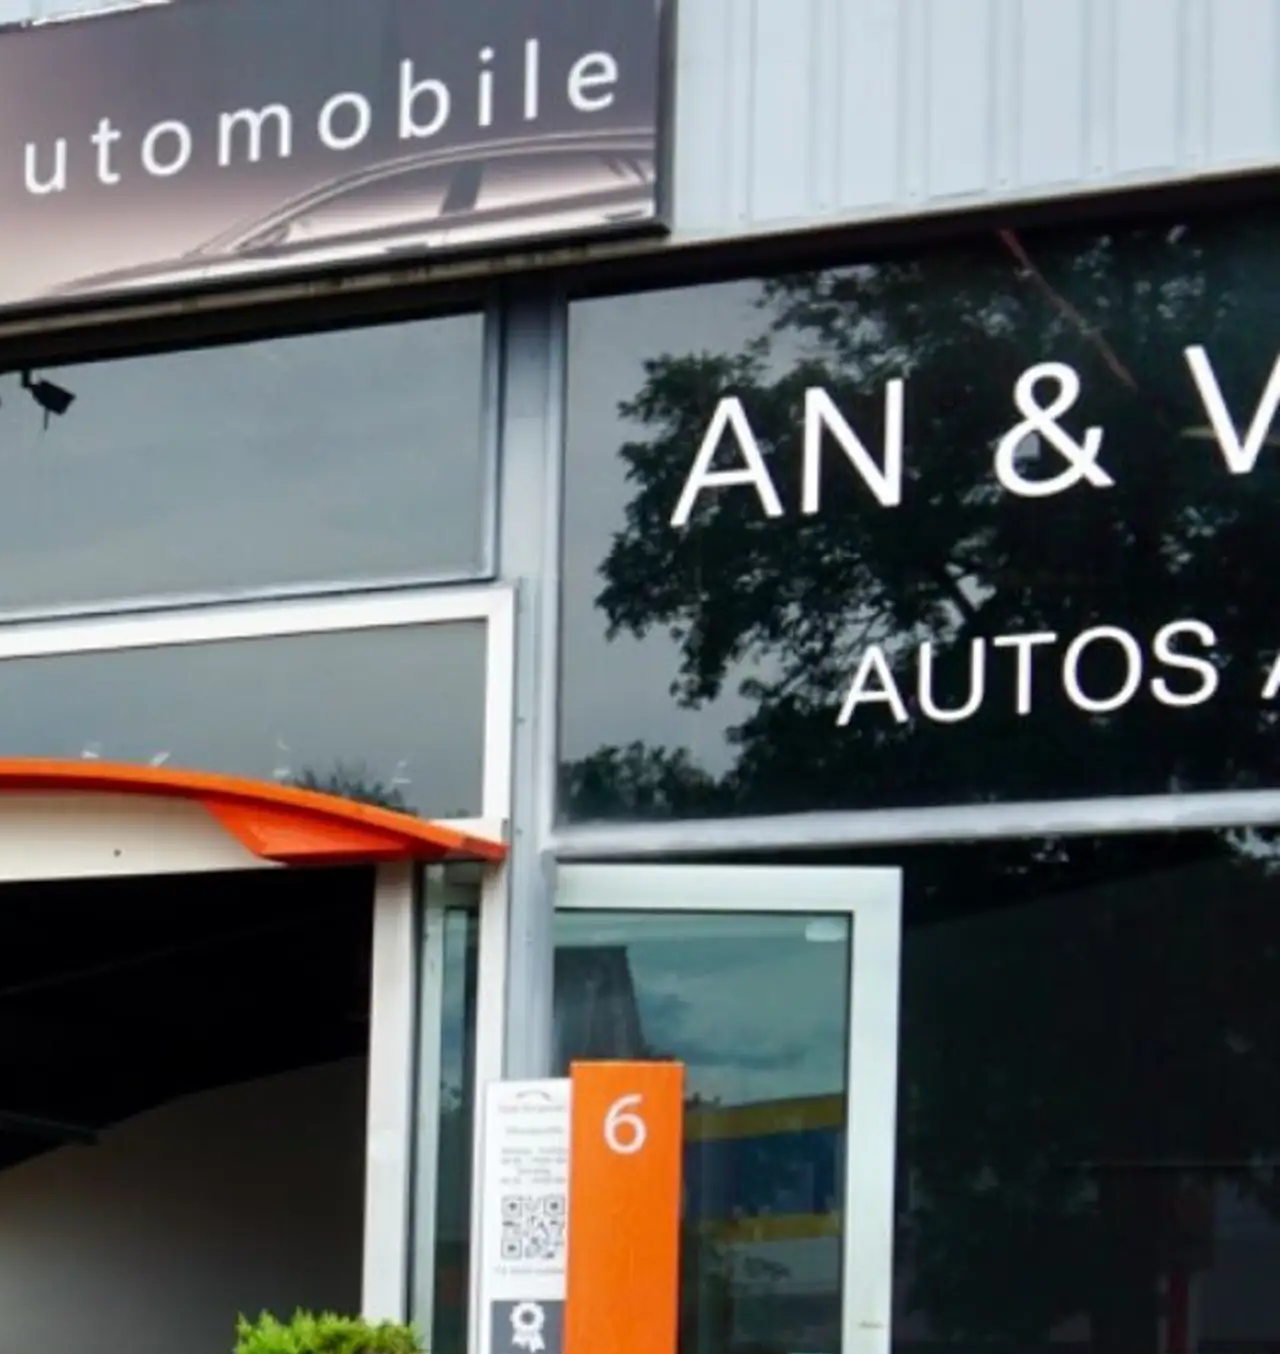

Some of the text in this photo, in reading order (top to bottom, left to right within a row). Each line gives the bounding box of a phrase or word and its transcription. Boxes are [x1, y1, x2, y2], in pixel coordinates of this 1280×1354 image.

[669, 396, 904, 527] AN
[993, 361, 1114, 497] &
[835, 620, 1219, 726] AUTOS
[602, 1092, 648, 1156] 6
